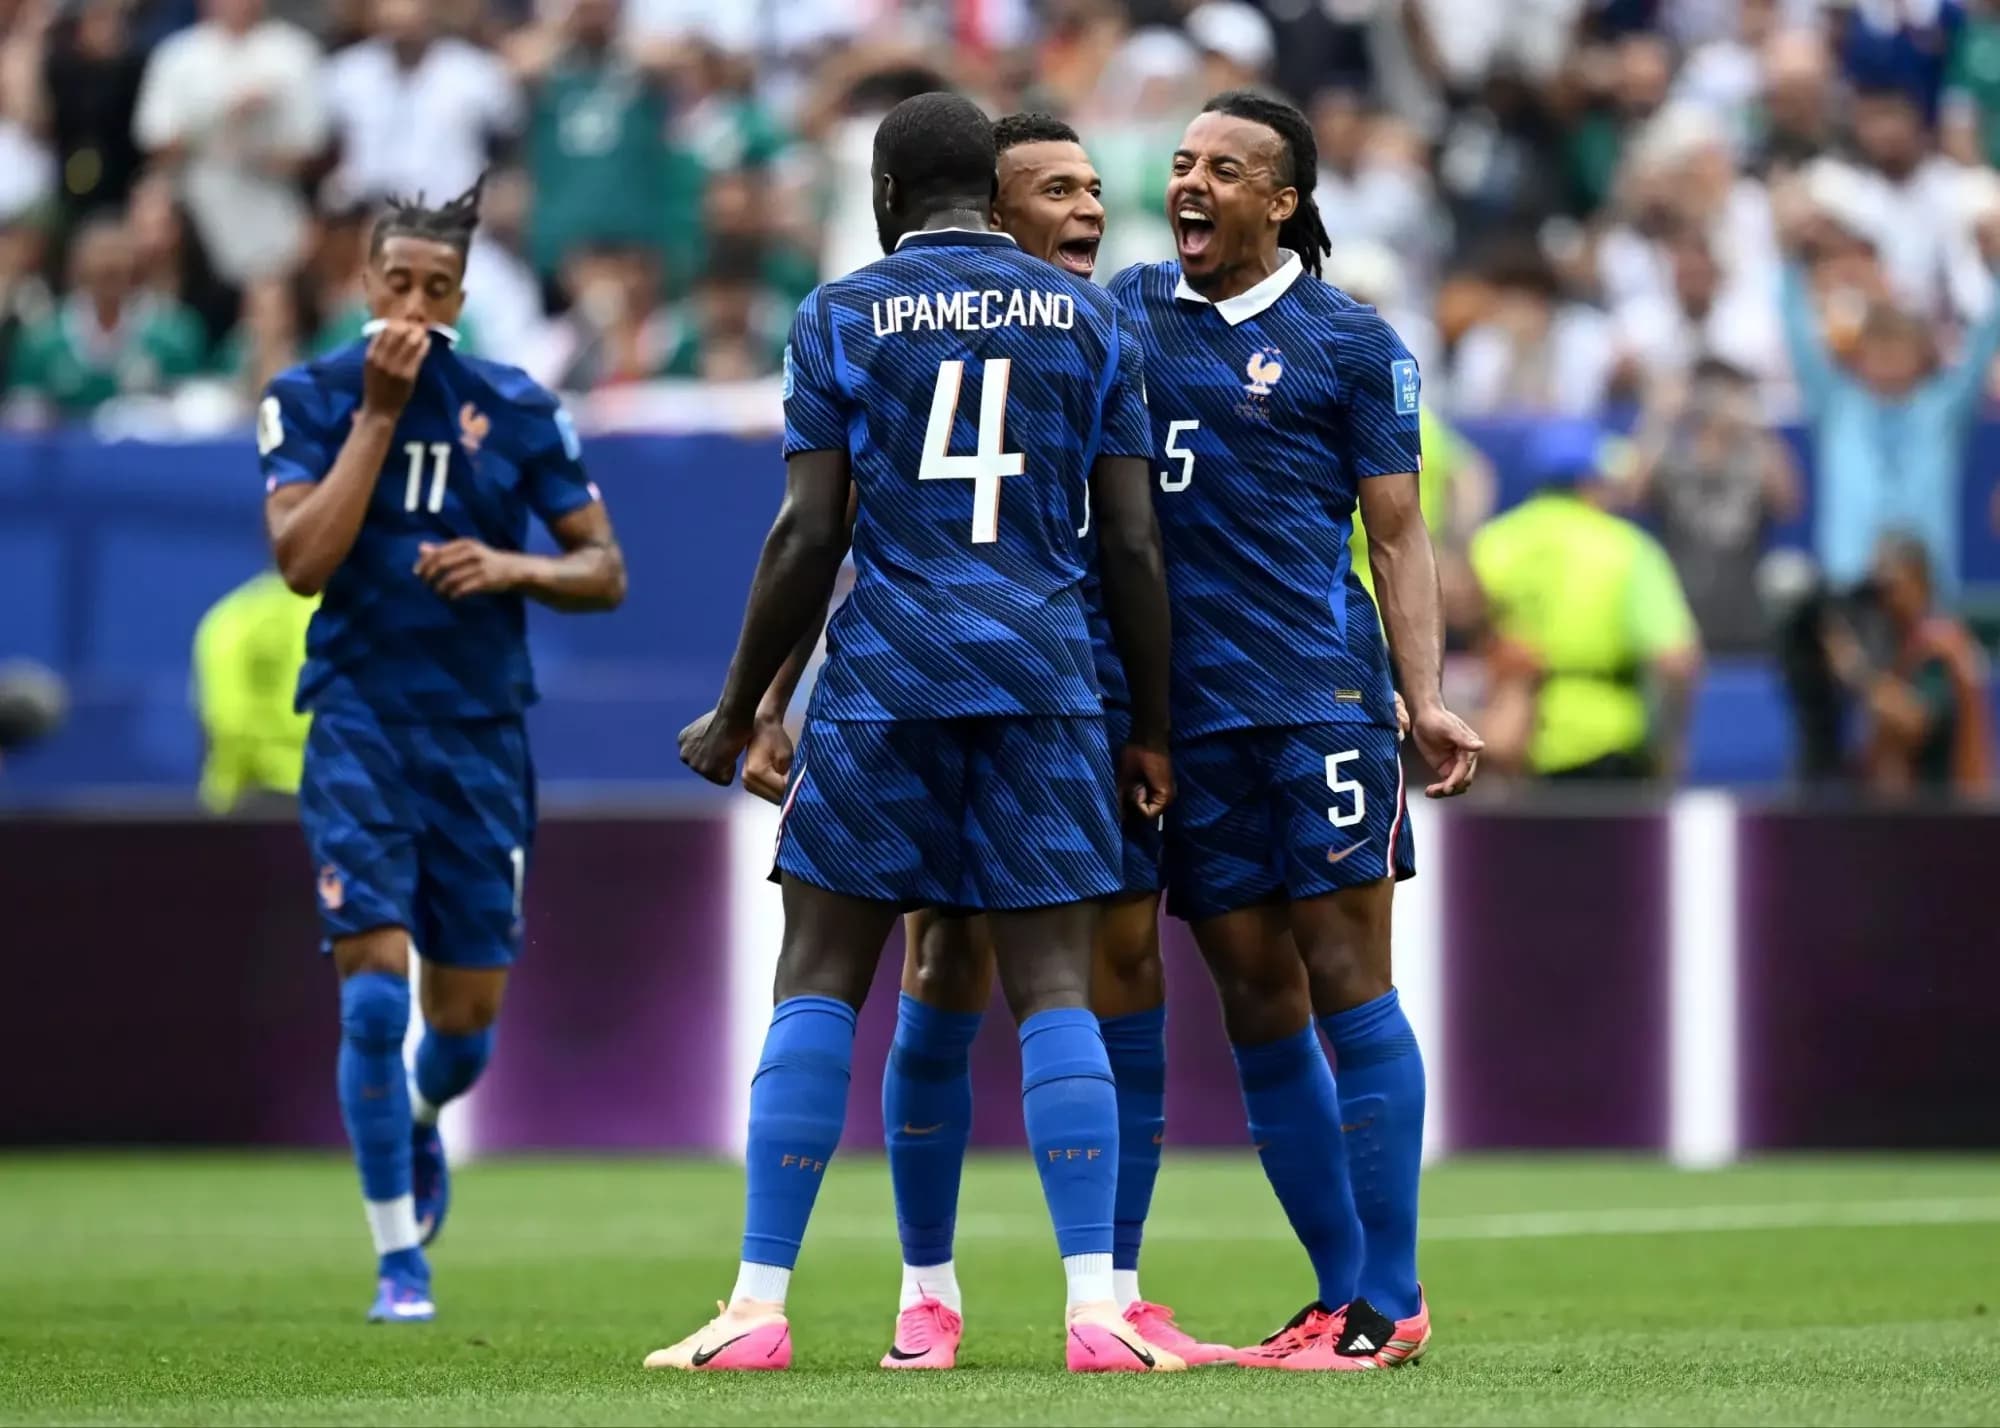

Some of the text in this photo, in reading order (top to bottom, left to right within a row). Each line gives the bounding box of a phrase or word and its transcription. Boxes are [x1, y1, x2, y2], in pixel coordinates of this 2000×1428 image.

[872, 288, 1074, 337] UPAMECANO
[404, 440, 451, 513] 11
[917, 358, 1025, 544] 4
[1160, 419, 1200, 493] 5
[1325, 749, 1365, 828] 5
[781, 1153, 824, 1171] FFF
[1048, 1148, 1101, 1162] FFF
